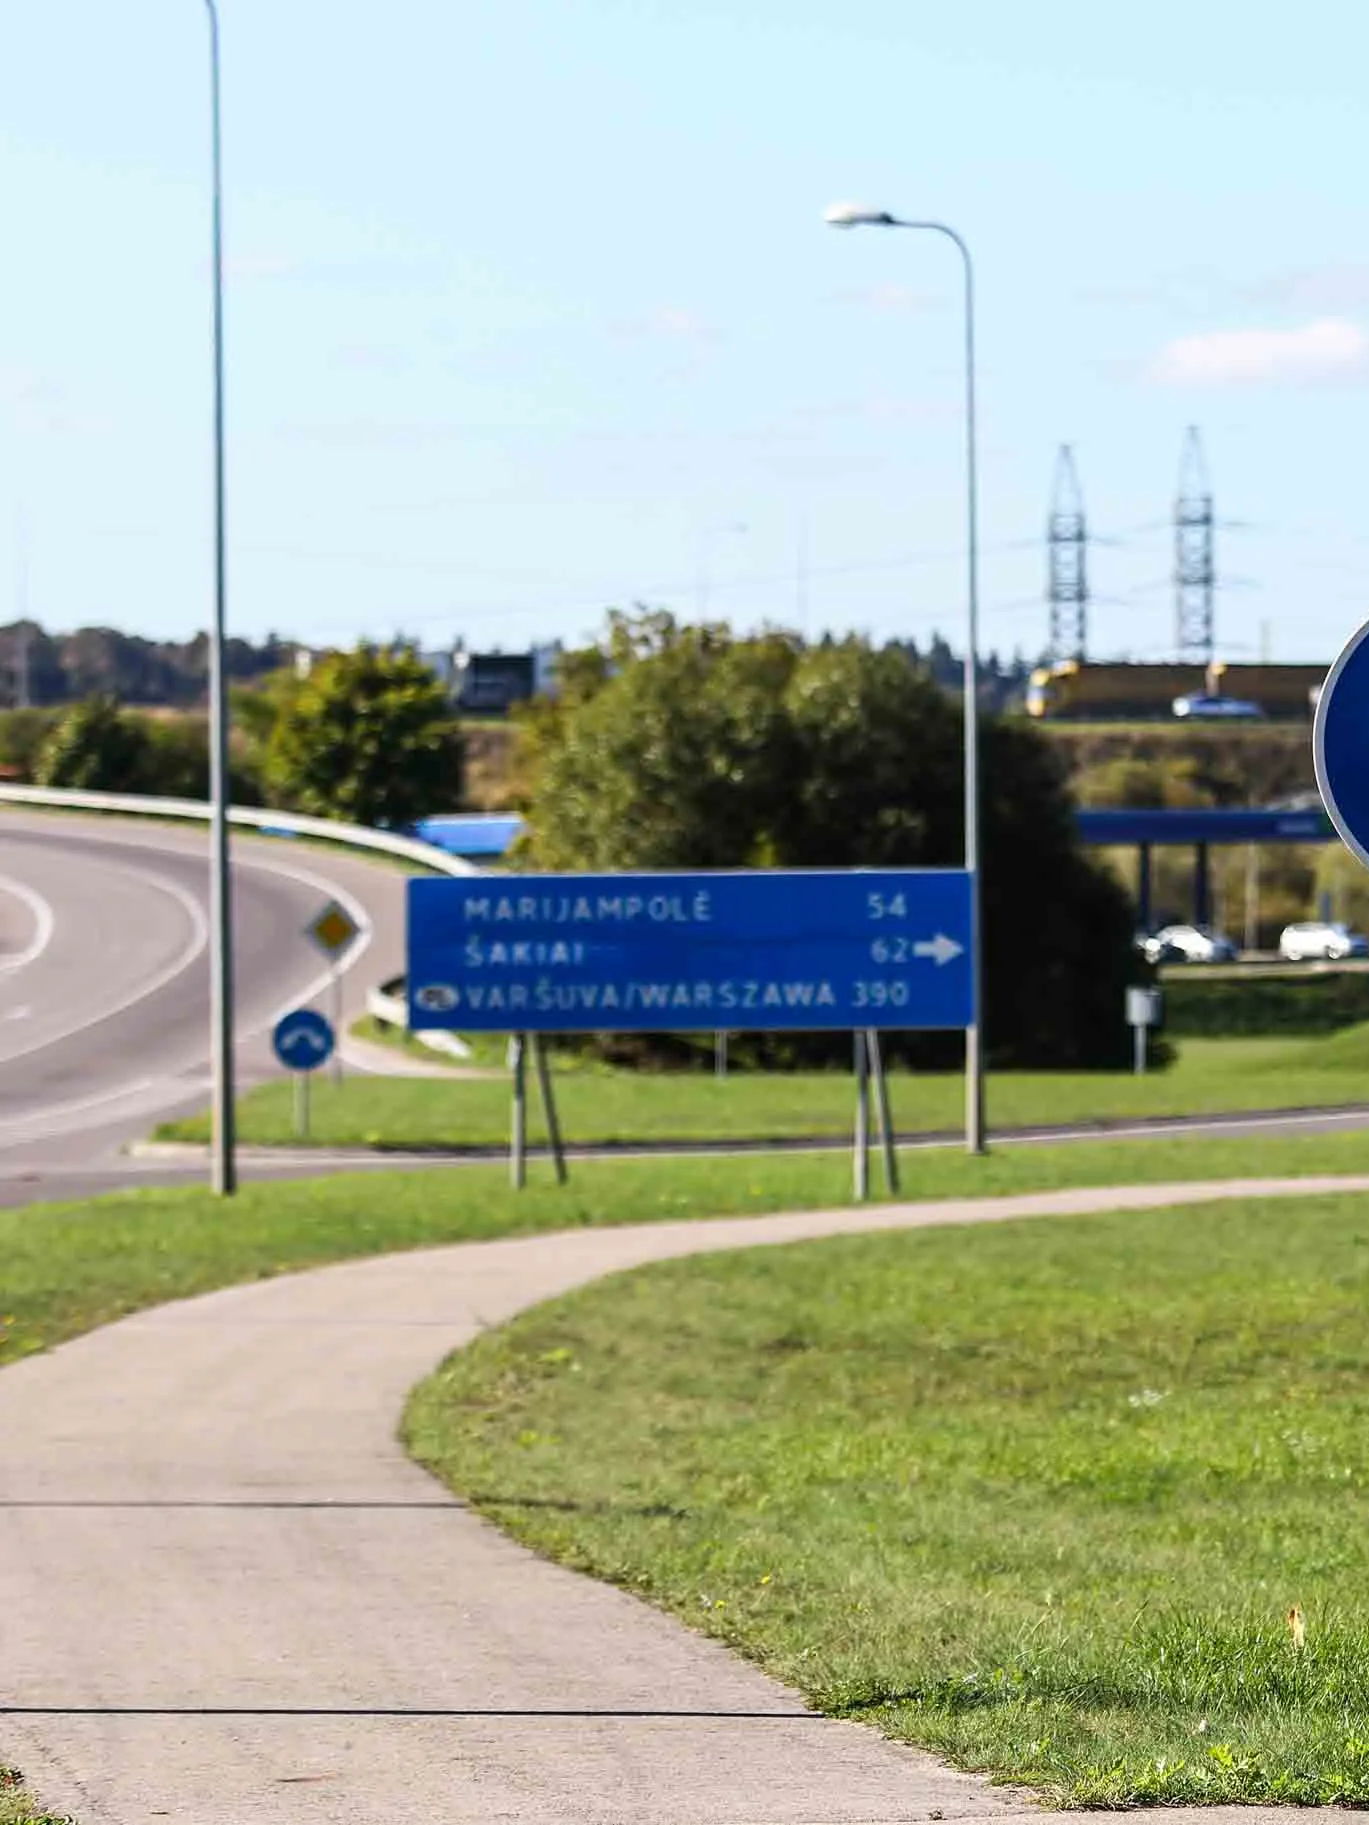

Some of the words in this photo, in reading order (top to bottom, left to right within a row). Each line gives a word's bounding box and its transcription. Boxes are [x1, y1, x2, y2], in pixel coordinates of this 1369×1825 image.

[866, 893, 907, 919] 54
[464, 935, 584, 967] ŠAKIAI
[871, 938, 908, 964] 62
[850, 981, 910, 1007] 390
